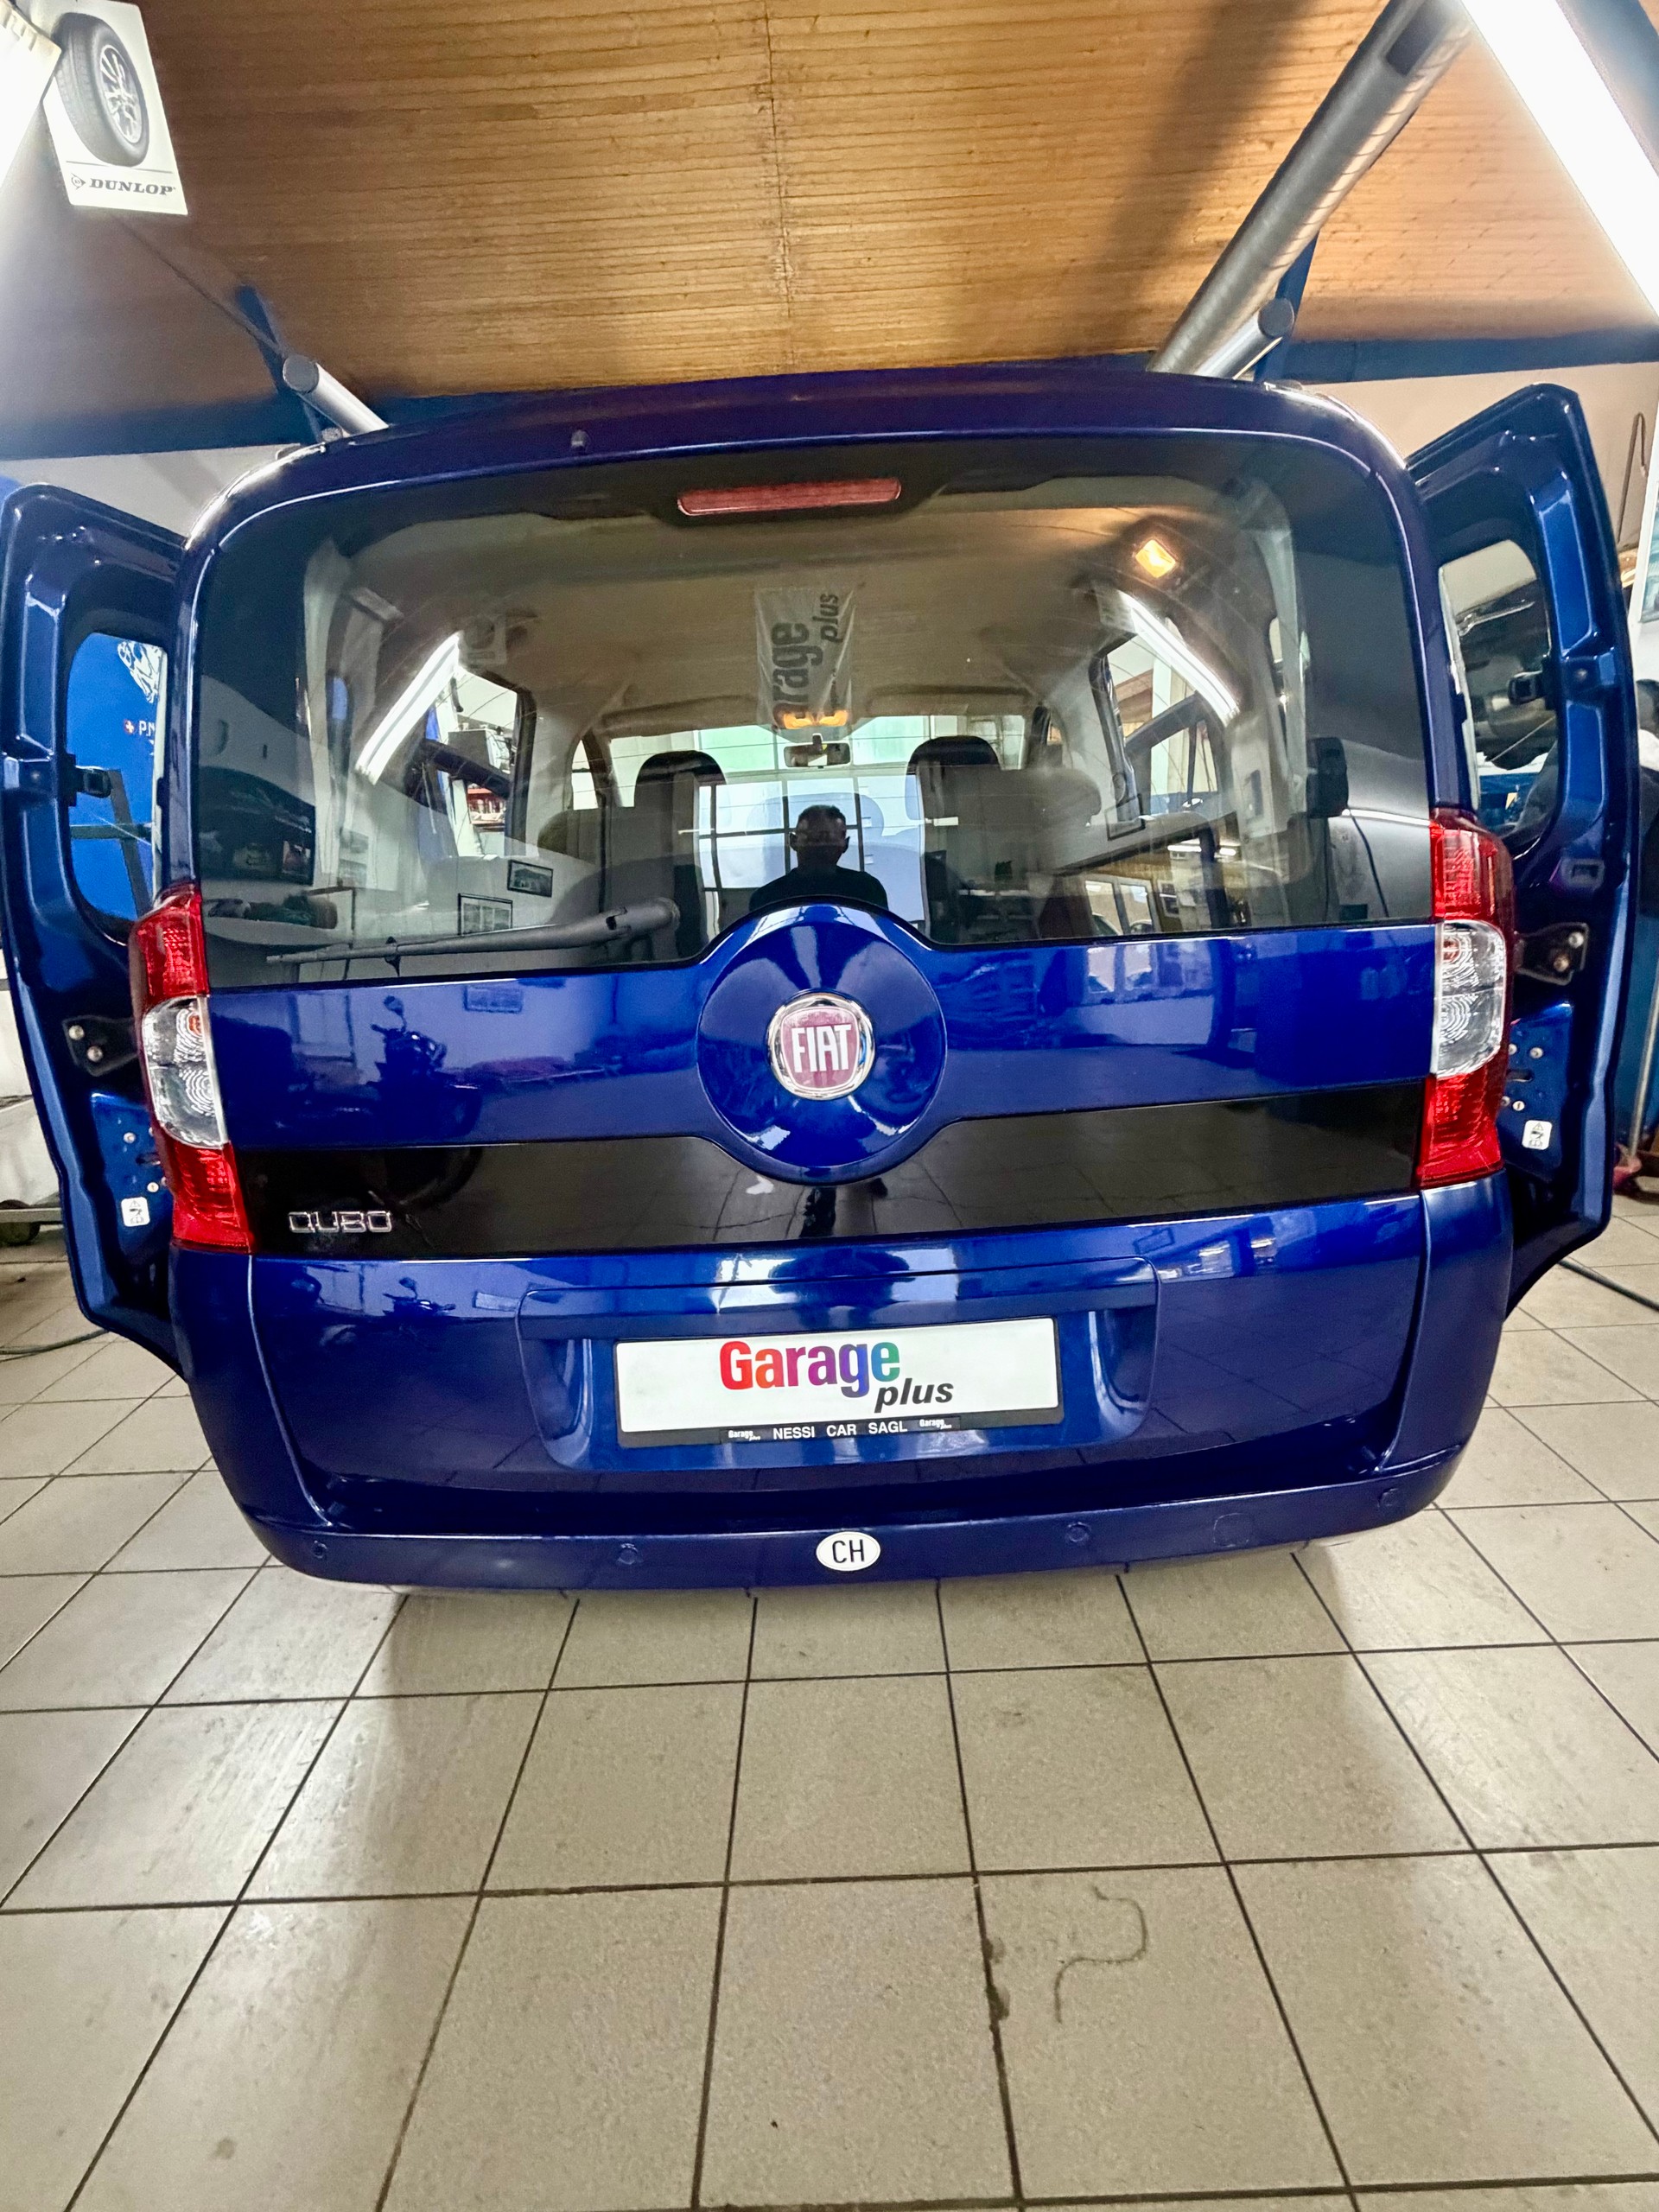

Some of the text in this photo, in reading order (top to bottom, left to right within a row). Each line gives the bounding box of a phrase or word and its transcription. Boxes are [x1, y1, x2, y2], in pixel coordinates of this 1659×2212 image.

[89, 178, 174, 195] DUNLOP
[812, 593, 843, 644] plus
[791, 1024, 852, 1073] FIAT
[288, 1211, 392, 1233] QUBO
[719, 1340, 900, 1398] Garage
[874, 1377, 955, 1414] plus
[728, 1430, 754, 1440] Garage
[772, 1426, 815, 1440] NESSI
[826, 1422, 857, 1438] CAR
[868, 1421, 908, 1434] SAGL
[919, 1419, 945, 1428] Garage
[832, 1539, 865, 1564] CH
